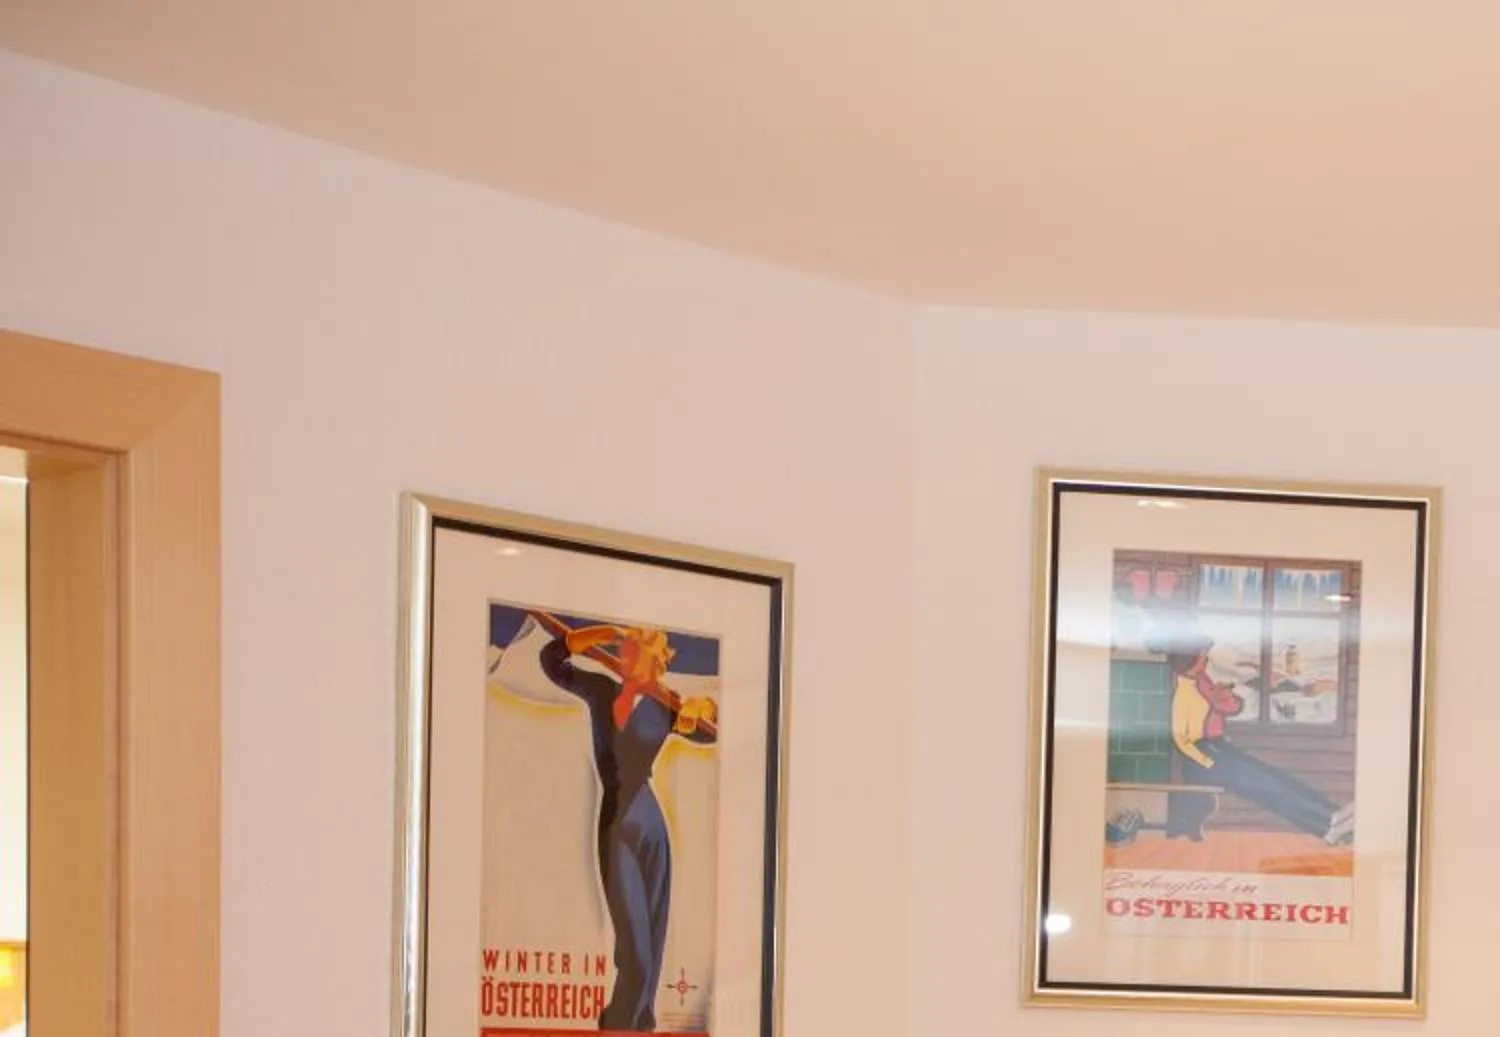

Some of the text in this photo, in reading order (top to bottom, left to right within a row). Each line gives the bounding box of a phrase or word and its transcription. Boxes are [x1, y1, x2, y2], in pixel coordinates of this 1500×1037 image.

[483, 949, 607, 976] WINTER IN
[481, 977, 606, 1020] ÖSTERREICH
